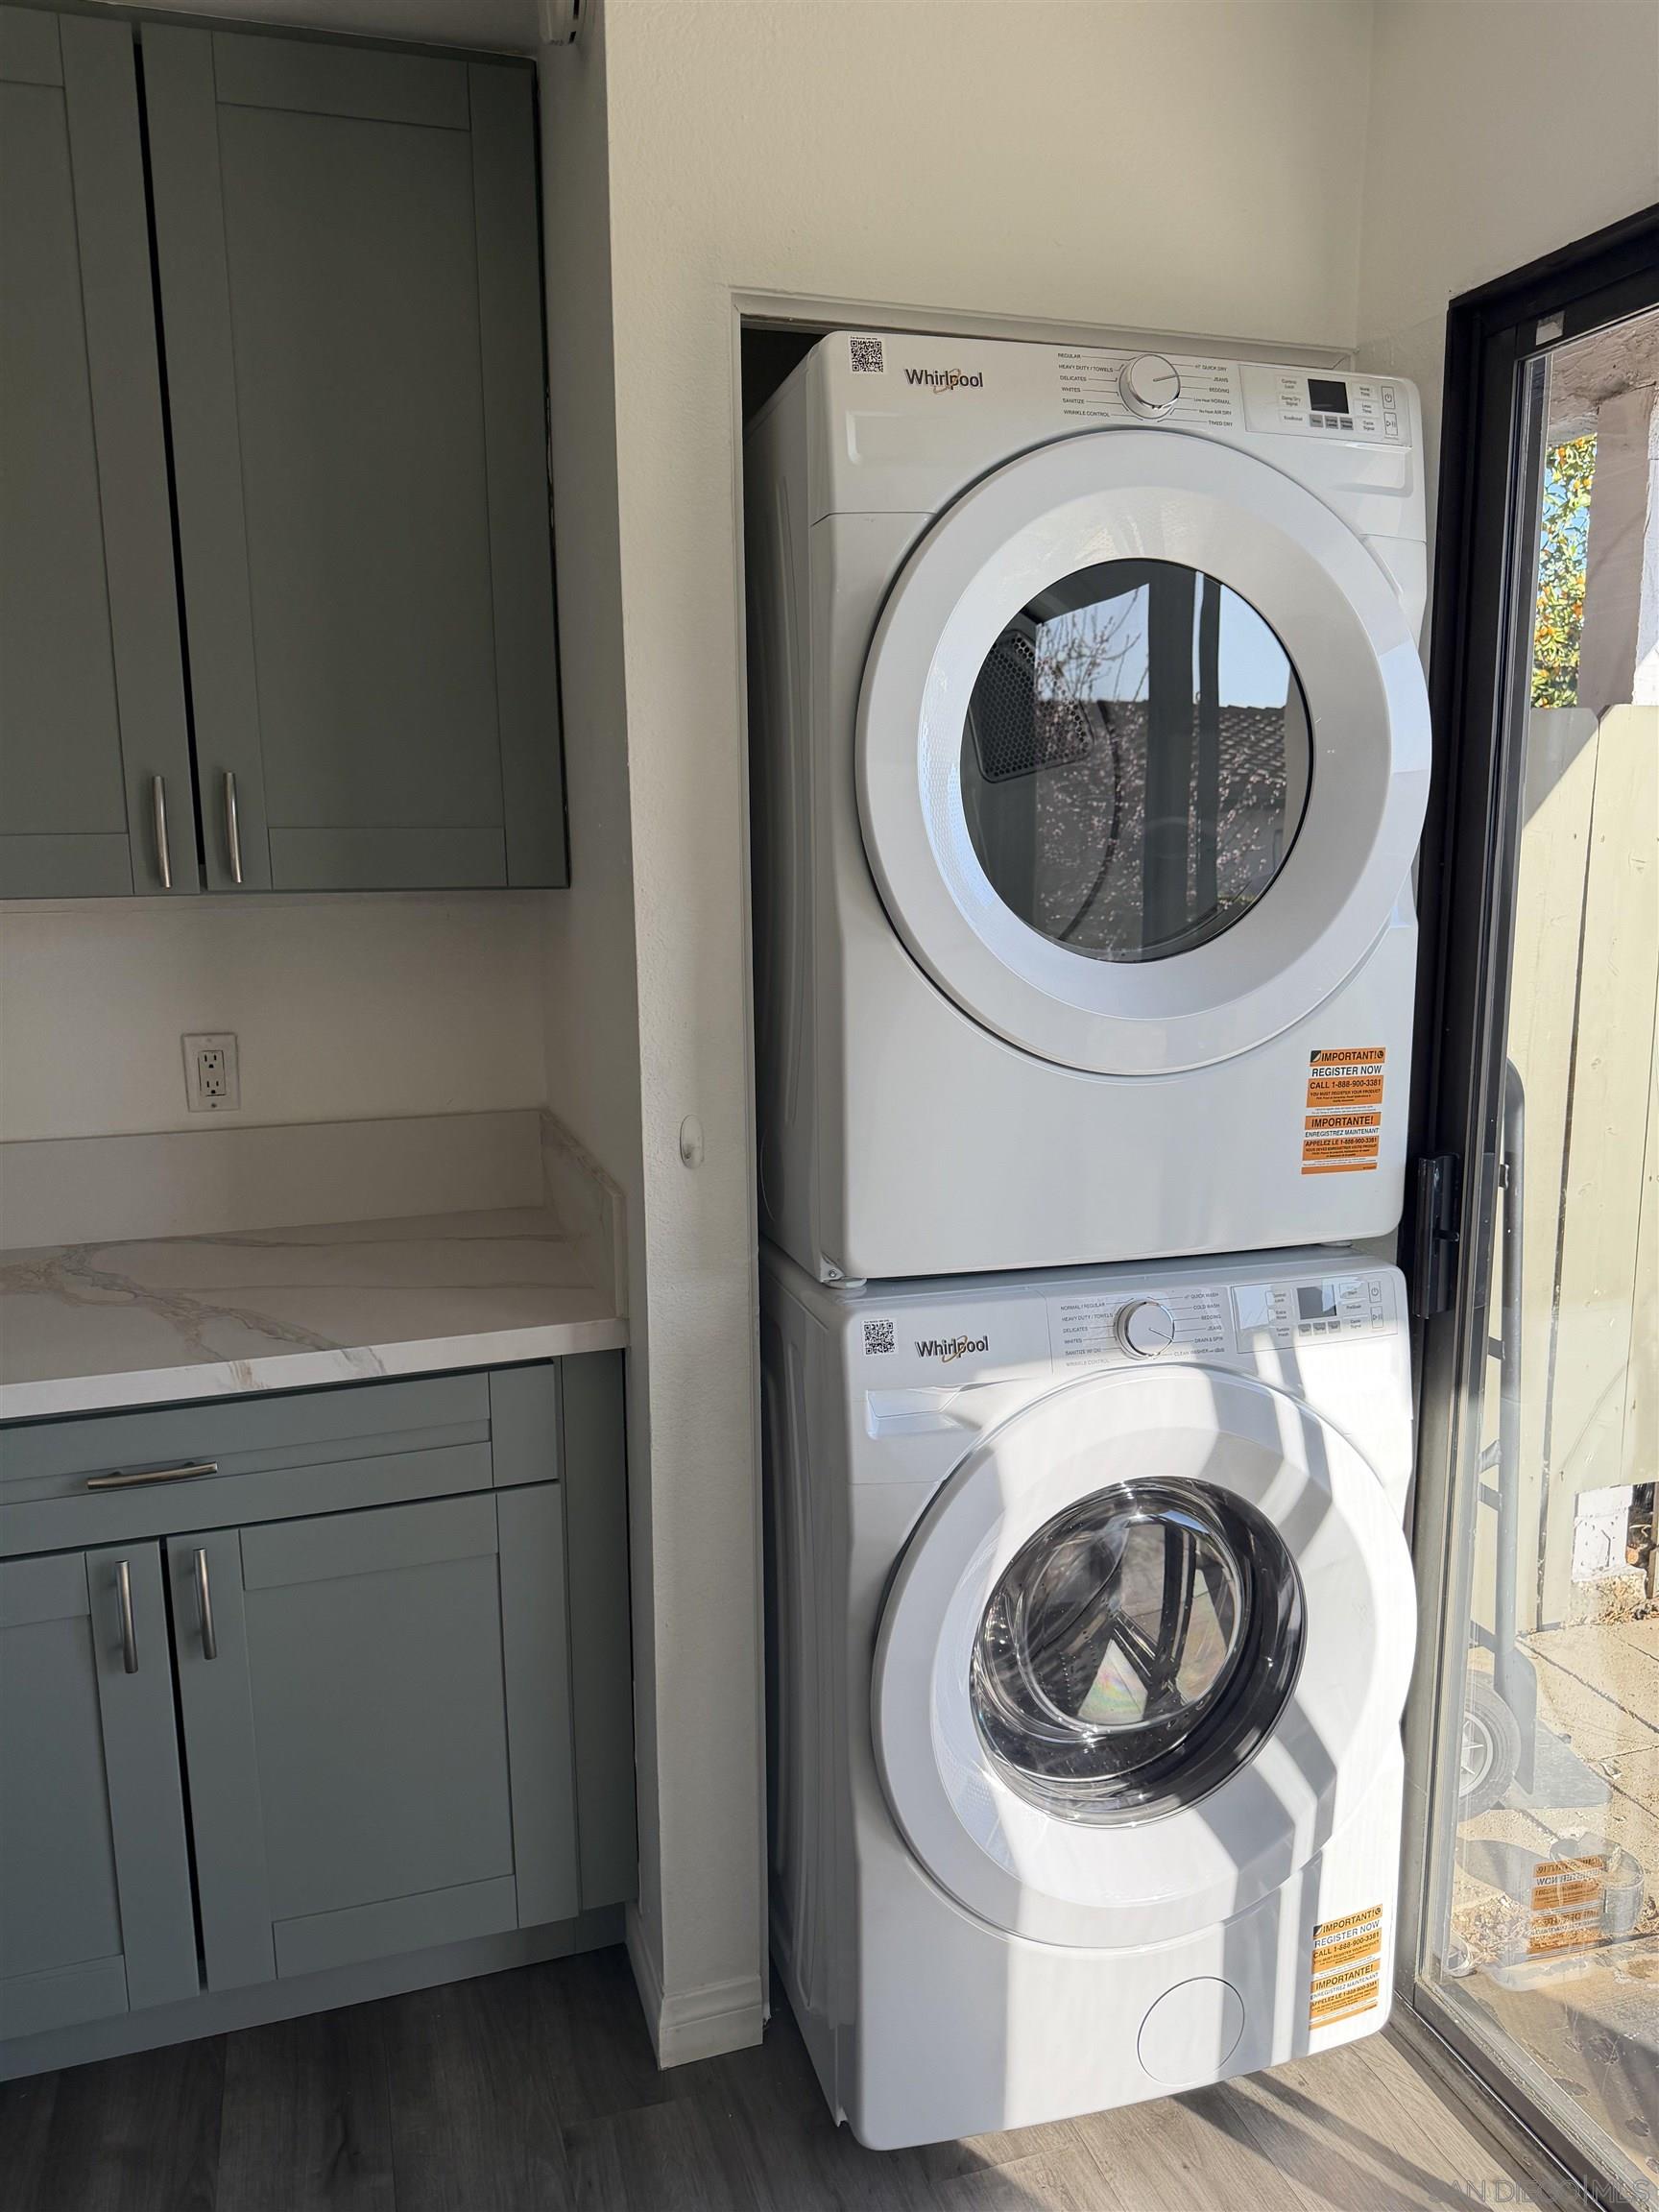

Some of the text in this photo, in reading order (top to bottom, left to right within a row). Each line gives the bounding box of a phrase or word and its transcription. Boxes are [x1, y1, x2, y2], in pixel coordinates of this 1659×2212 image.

[906, 369, 983, 390] Whirlpool
[1321, 1050, 1377, 1061] IMPORTANT!
[1312, 1065, 1382, 1077] REGISTER NOW
[1332, 1079, 1381, 1088] 1-888-900-3381
[1311, 1116, 1373, 1127] IMPORTANTE!
[914, 1335, 989, 1358] Whirlpool
[1323, 1909, 1375, 1934] IMPORTANT!
[1314, 1920, 1380, 1948] REGISTER NOW
[1313, 1949, 1332, 1959] CALL
[1334, 1932, 1380, 1952] 1-888-900-3381
[1315, 1964, 1374, 1990] IMPORTANTE!
